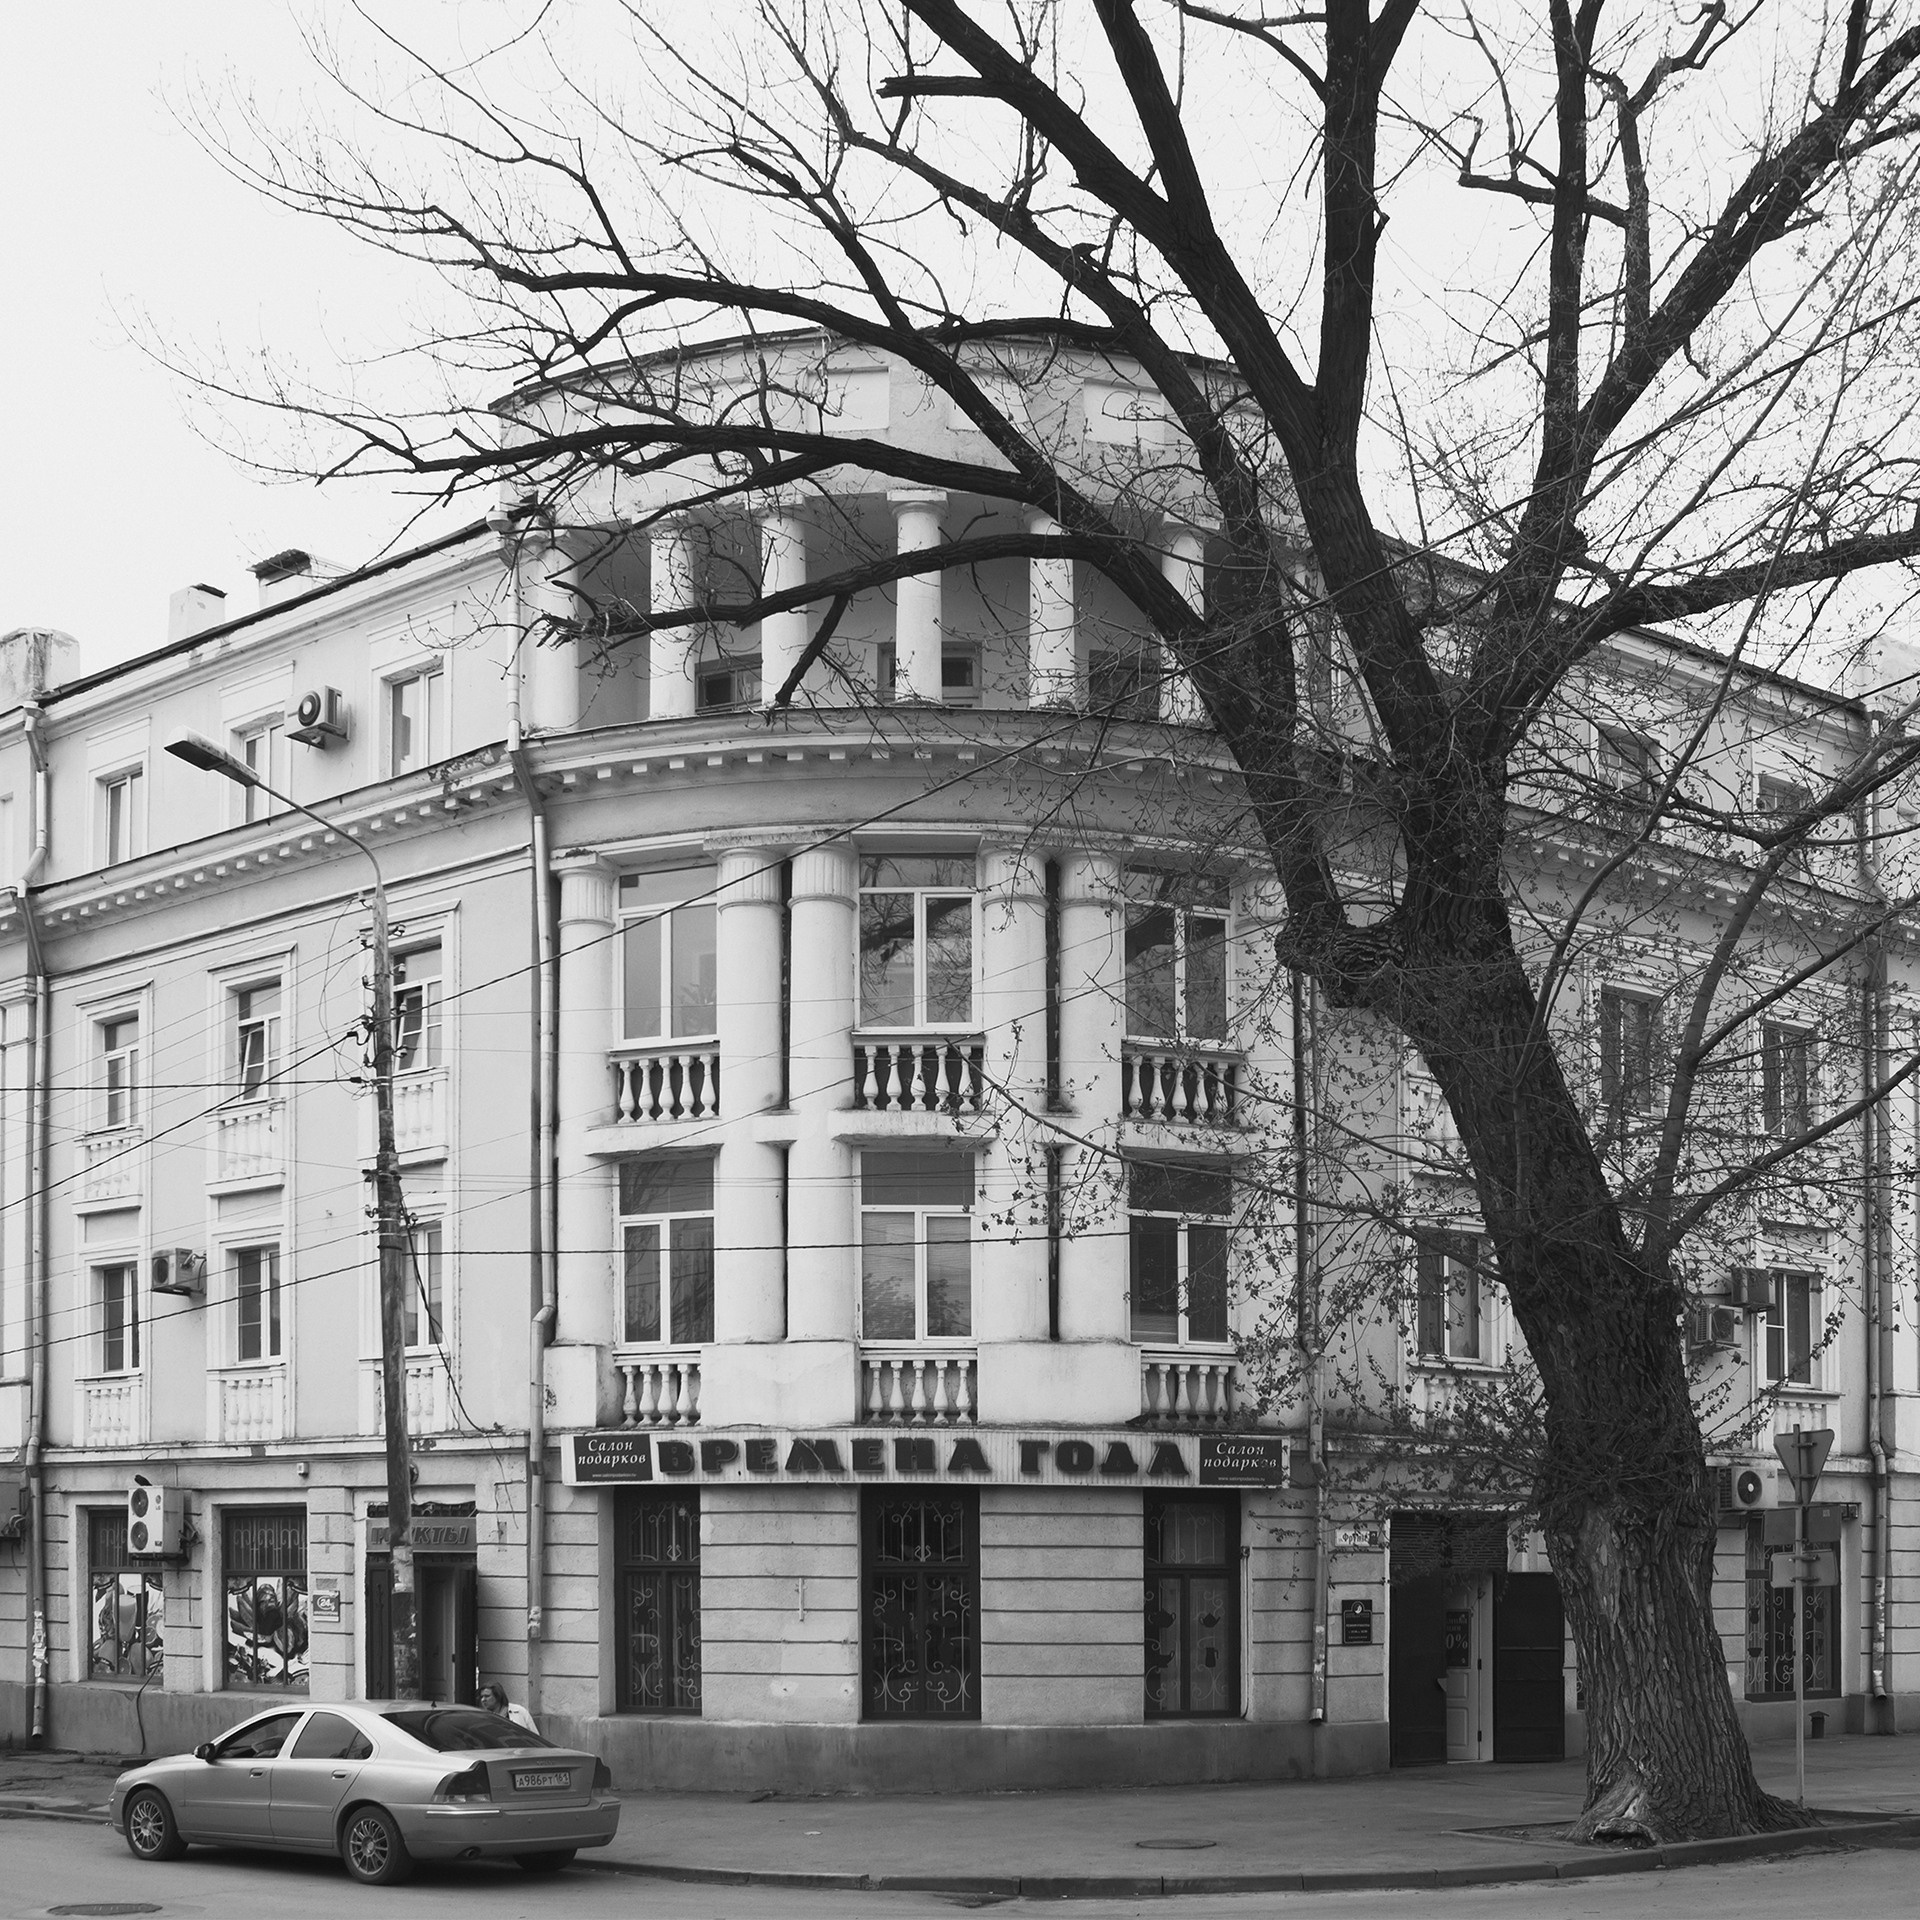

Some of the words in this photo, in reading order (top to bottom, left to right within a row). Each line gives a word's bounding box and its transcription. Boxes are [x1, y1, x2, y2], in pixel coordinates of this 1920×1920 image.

[588, 1439, 633, 1452] Салон
[1216, 1442, 1264, 1455] Салон
[578, 1452, 646, 1467] подарков
[656, 1437, 992, 1475] ВРЕМЕНА
[1018, 1439, 1190, 1476] ГОДА
[1203, 1455, 1277, 1471] подарков
[371, 1527, 470, 1546] ПРКТЫ
